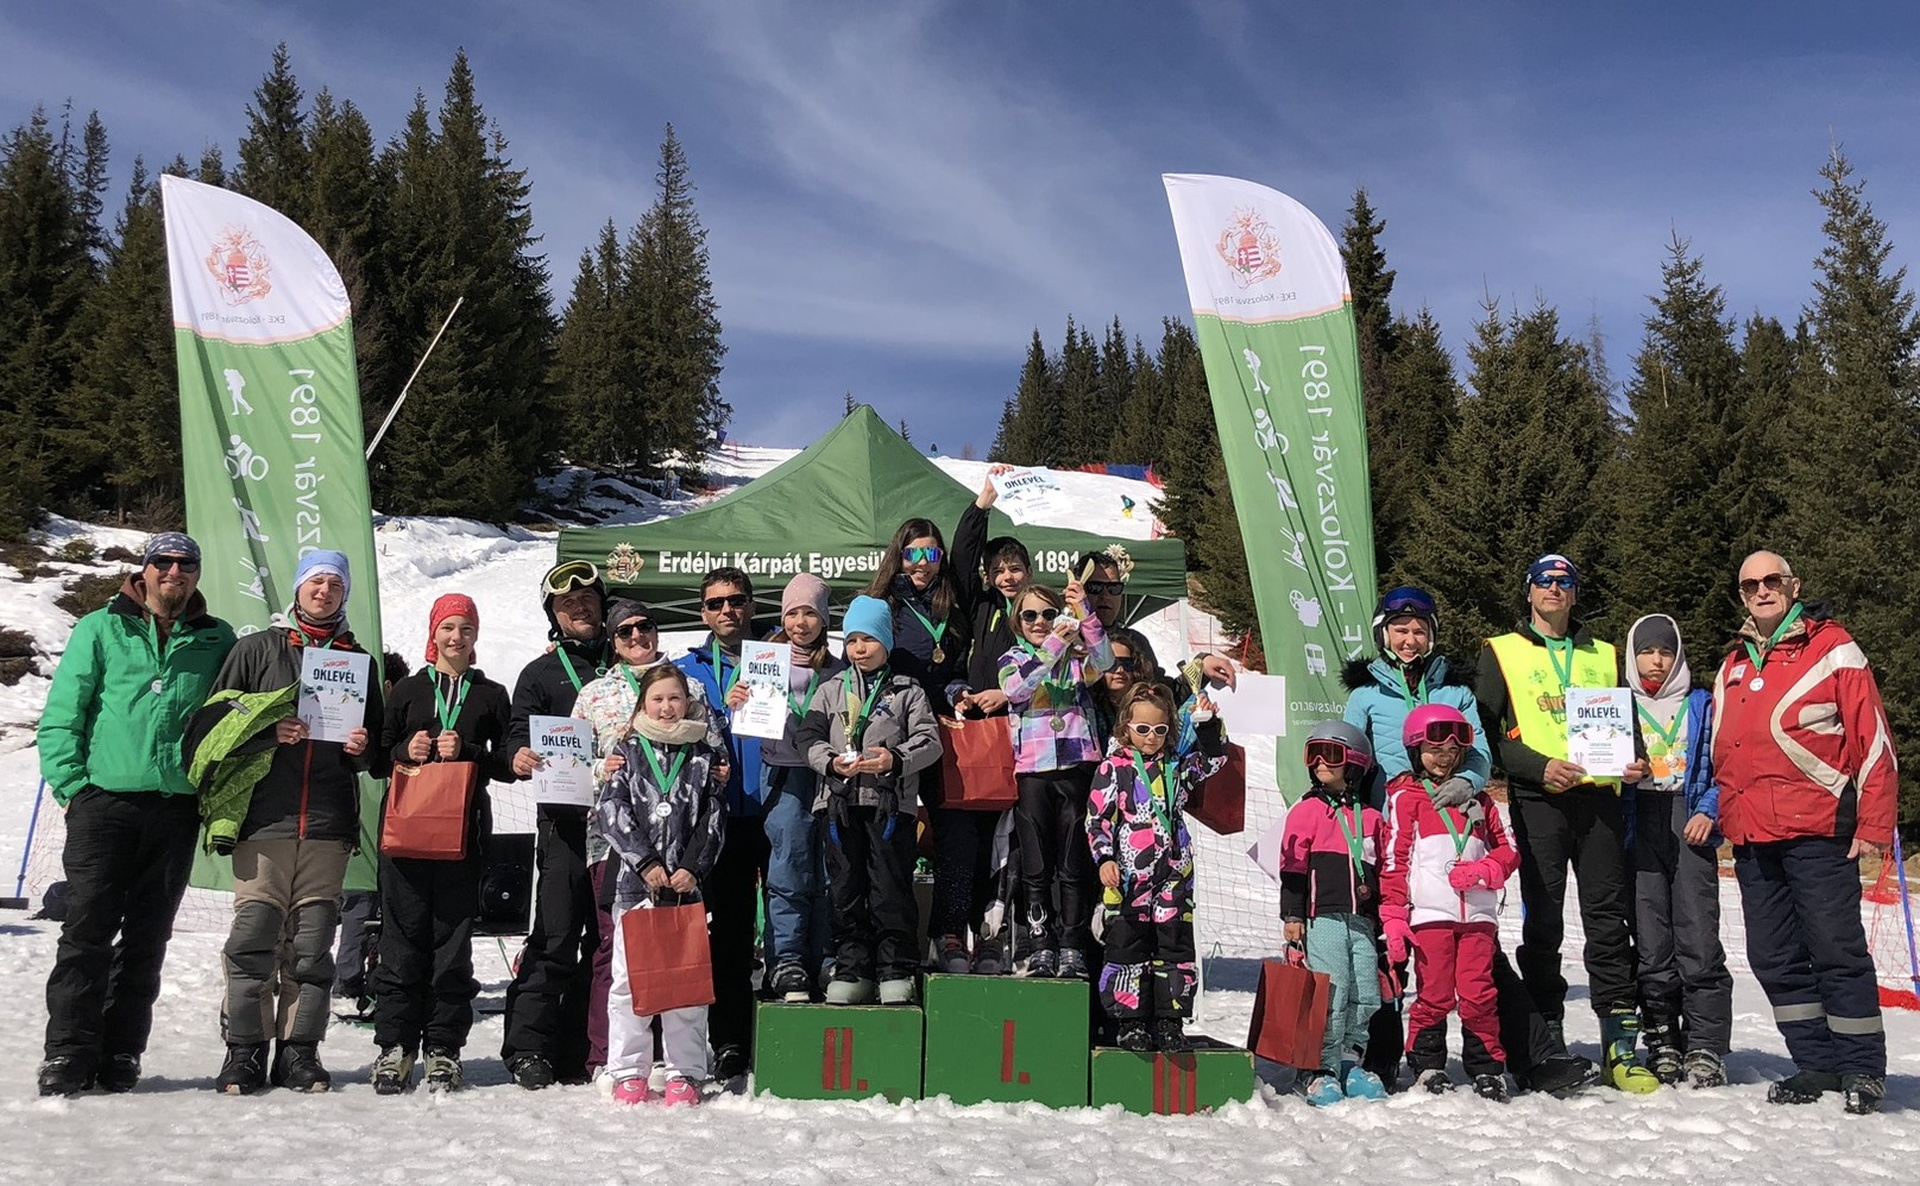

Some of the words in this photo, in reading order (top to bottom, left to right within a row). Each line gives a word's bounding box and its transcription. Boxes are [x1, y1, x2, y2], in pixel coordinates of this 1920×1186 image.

[1004, 475, 1046, 489] OKLEVÉL
[658, 551, 728, 574] Erdélyi
[734, 551, 803, 579] Kárpát
[1034, 550, 1080, 573] 1891
[313, 668, 356, 684] OKLEVÉL
[748, 661, 781, 677] OKLEVÉL
[1577, 704, 1622, 719] OKLEVÉL
[541, 734, 582, 749] OKLEVÉL
[822, 1026, 869, 1092] II.
